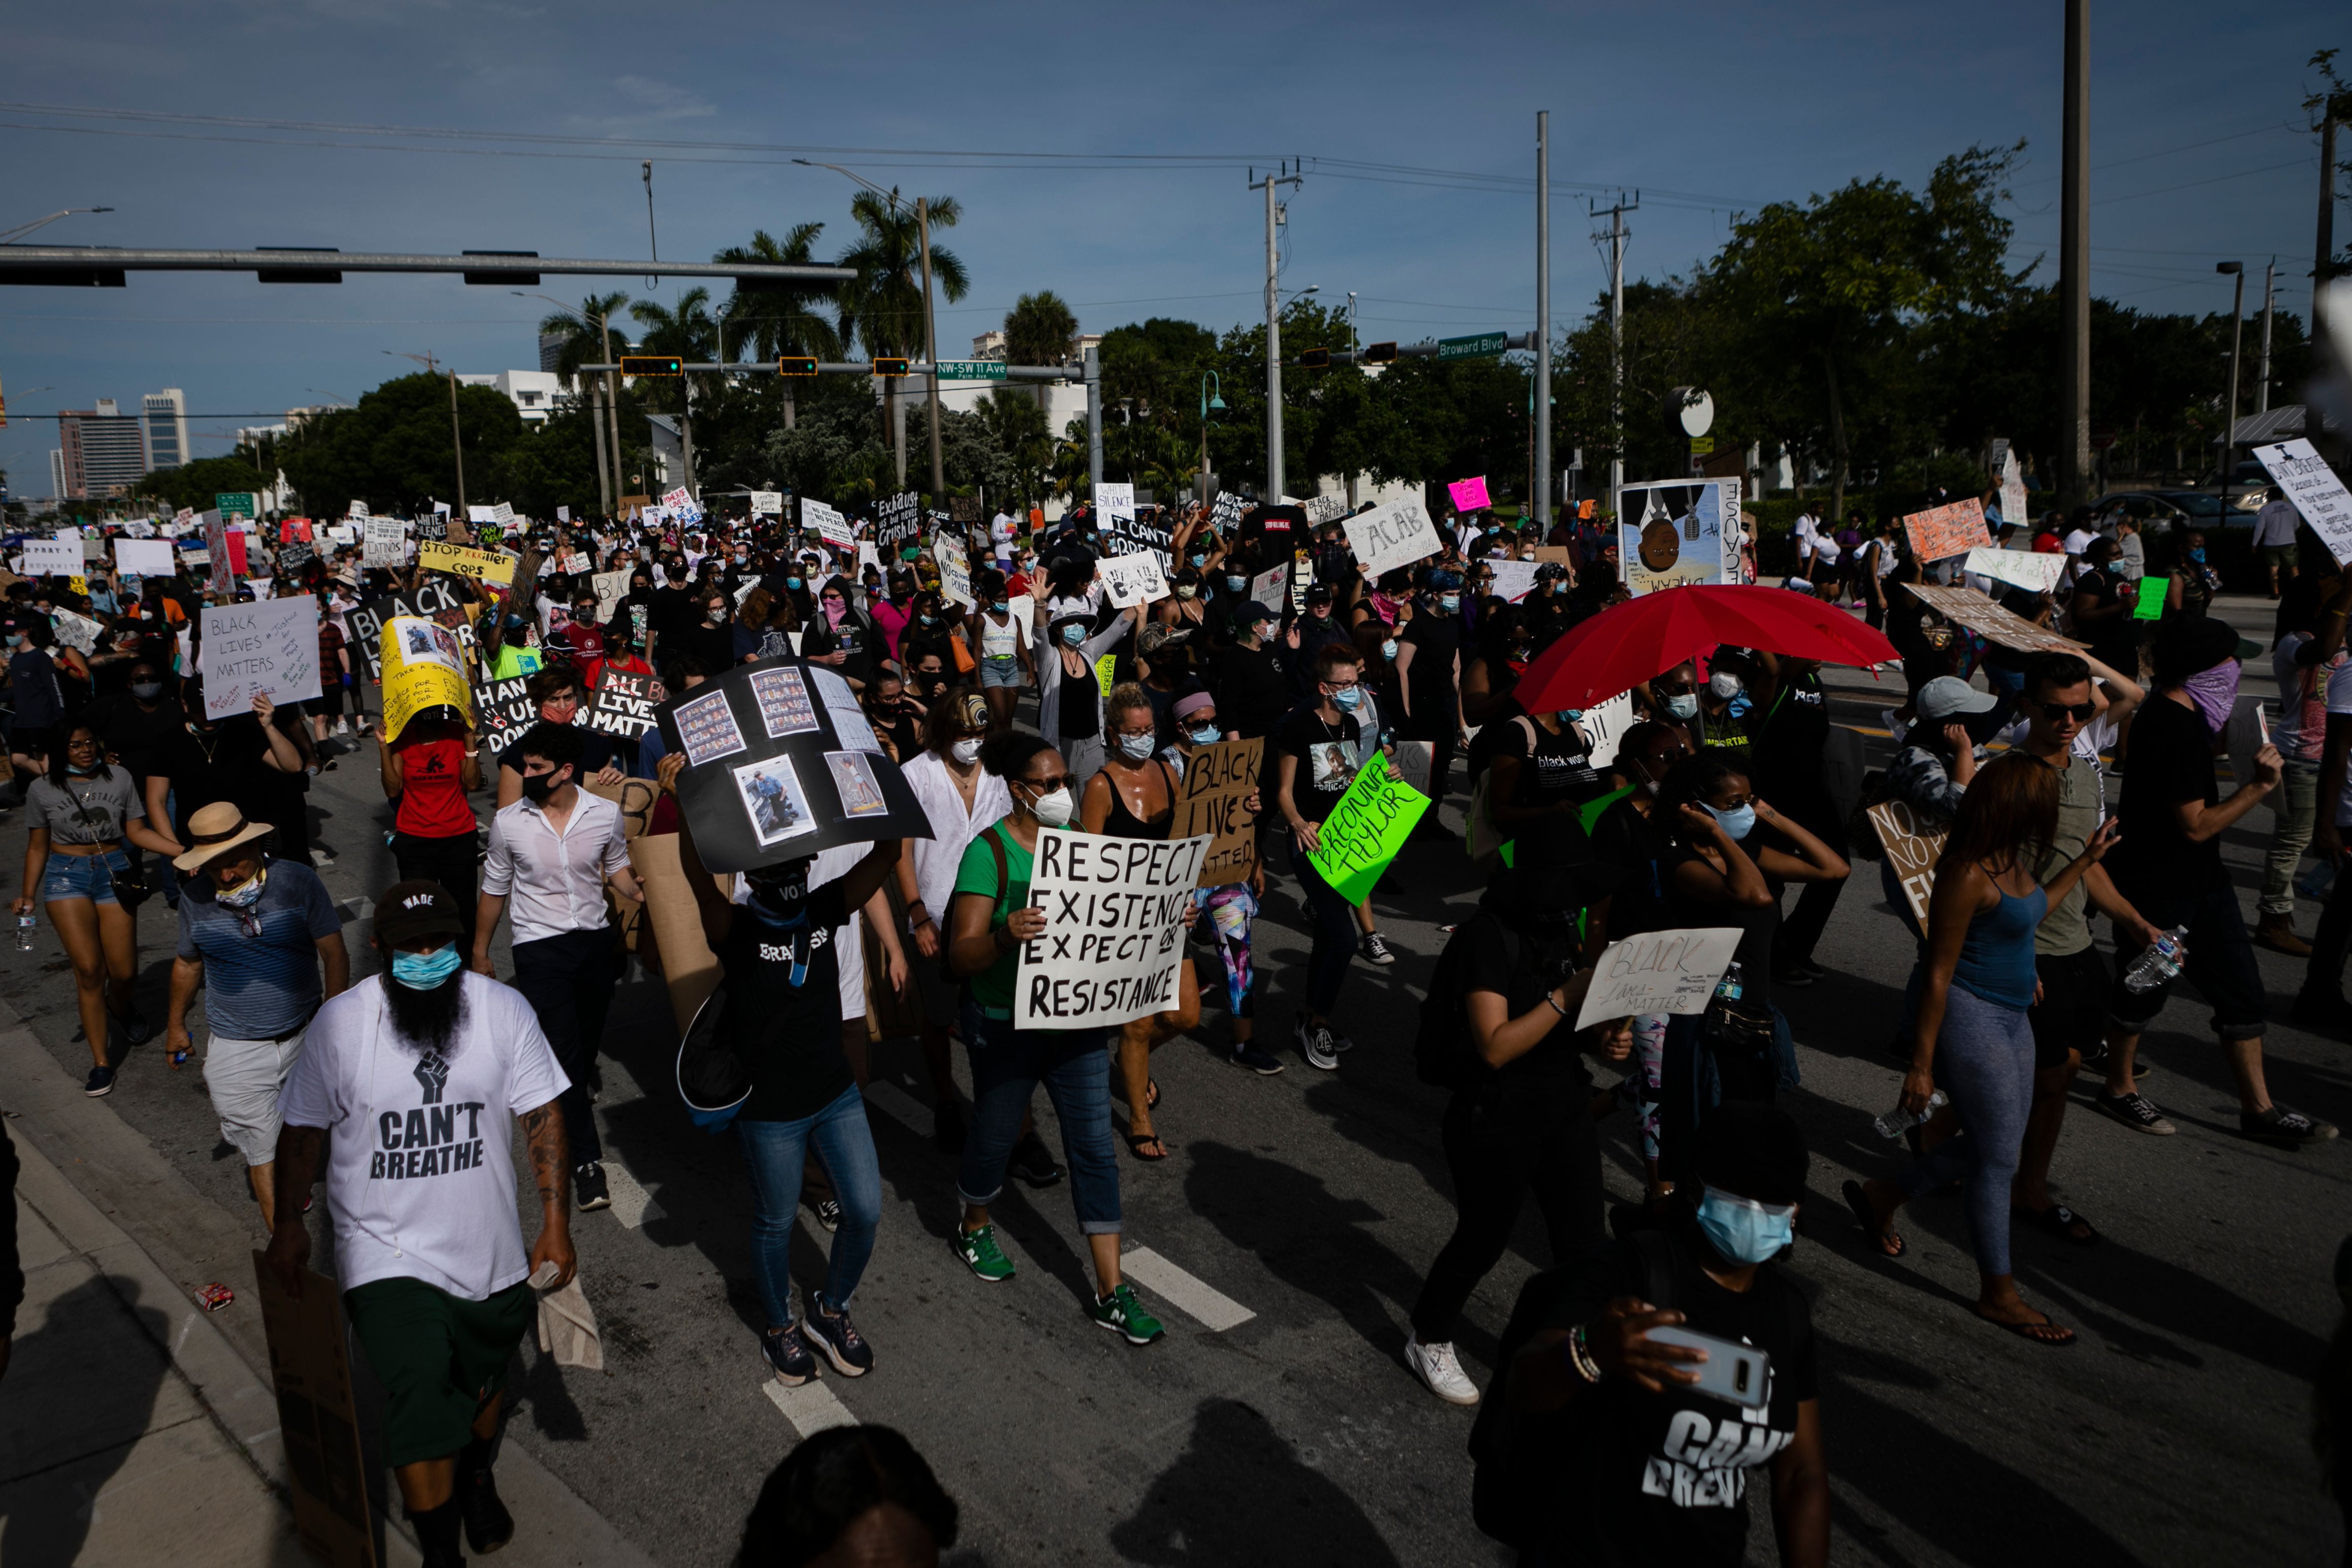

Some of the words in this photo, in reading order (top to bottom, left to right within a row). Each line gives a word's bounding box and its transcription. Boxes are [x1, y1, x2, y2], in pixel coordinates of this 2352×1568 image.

[1440, 340, 1478, 356] Broward
[1481, 337, 1503, 351] Blvd
[938, 364, 973, 373] NW-SW
[976, 364, 984, 373] 11
[986, 364, 1005, 373] Ave
[663, 491, 681, 504] POWER
[1100, 485, 1127, 496] WHITE
[1216, 490, 1235, 505] NO
[668, 500, 683, 509] LOVE
[879, 491, 918, 517] Exhaust
[1098, 495, 1131, 508] SILENCE
[1211, 504, 1231, 516] NO
[1308, 495, 1330, 509] BLACK
[1314, 500, 1338, 514] LIVES
[414, 512, 442, 525] WHITE
[684, 513, 702, 526] OWER
[687, 507, 694, 515] OF
[879, 519, 887, 529] us
[890, 513, 899, 524] but
[901, 508, 918, 520] never
[1320, 506, 1345, 522] MATTER
[815, 513, 825, 522] NO
[826, 517, 846, 529] PEACE
[1210, 516, 1226, 526] NO
[1265, 521, 1274, 529] STOP
[1274, 521, 1285, 529] KILLING
[415, 524, 447, 537] SILENCE
[1114, 516, 1126, 534] I
[1129, 521, 1168, 547] CAN'T
[1366, 506, 1424, 557] ACAB
[368, 542, 401, 554] LATINOS
[940, 533, 949, 547] NO
[424, 542, 461, 557] STOP
[465, 550, 509, 565] KKKiller
[946, 549, 954, 562] NO
[1117, 537, 1177, 579] BRETHE
[452, 563, 485, 575] COPS
[941, 559, 951, 577] NO
[595, 575, 629, 600] BLAC
[951, 578, 970, 596] POLICE
[1255, 574, 1269, 592] NO
[352, 581, 458, 640] BLACK
[211, 614, 257, 636] BLACK
[220, 635, 262, 655] LIVES
[217, 657, 274, 680] MATTERS
[393, 668, 415, 681] TAKE
[1103, 658, 1114, 691] FOREVER
[604, 673, 642, 697] ALL
[421, 711, 440, 720] VOTE
[1538, 755, 1568, 768] black
[1187, 744, 1259, 800] BLACK
[1186, 795, 1254, 837] LIVES
[1313, 762, 1389, 875] BREONNA
[1871, 800, 1916, 847] NO
[1337, 787, 1418, 874] TAYLOR
[1041, 835, 1201, 886] RESPECT
[1200, 842, 1254, 875] ATTER
[1887, 836, 1929, 876] NO
[402, 893, 434, 910] WADE
[1029, 888, 1193, 929] EXISTENCE
[1025, 933, 1153, 965] EXPECT
[1160, 925, 1175, 946] OR
[1607, 936, 1704, 981] BLACK
[1029, 965, 1176, 1018] RESISTANCE
[1623, 995, 1688, 1012] MATTER
[379, 1102, 485, 1151] CAN'T
[369, 1138, 483, 1180] BREATHE
